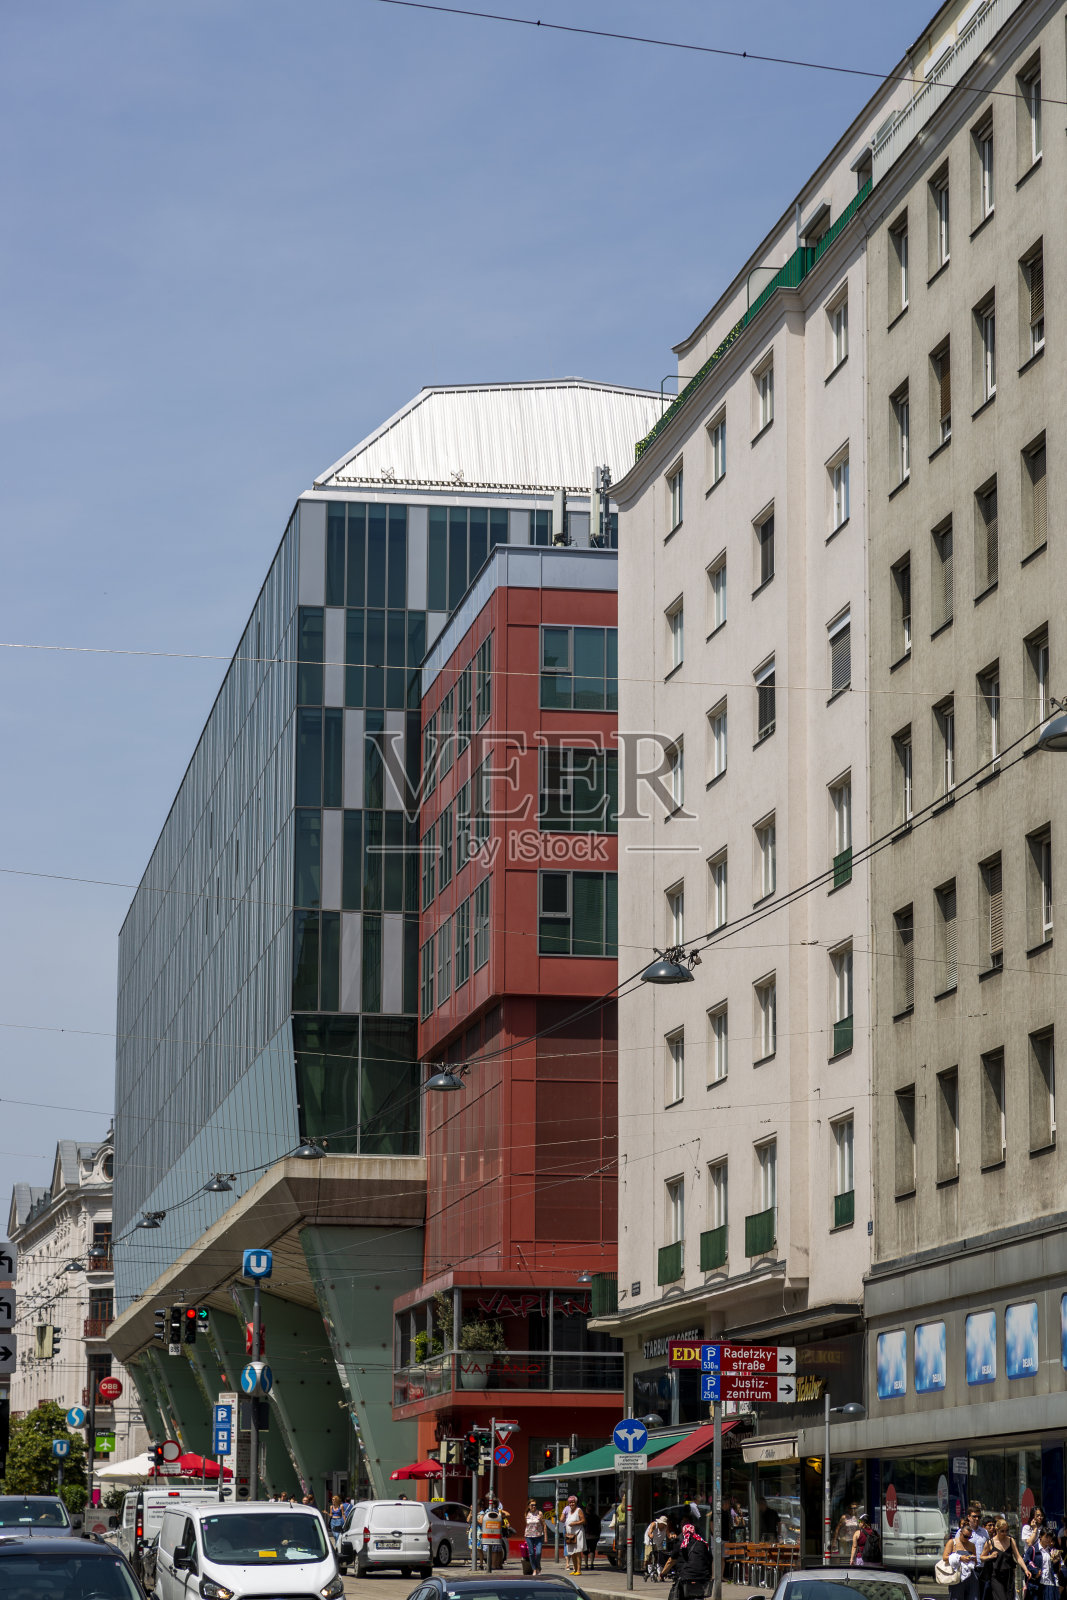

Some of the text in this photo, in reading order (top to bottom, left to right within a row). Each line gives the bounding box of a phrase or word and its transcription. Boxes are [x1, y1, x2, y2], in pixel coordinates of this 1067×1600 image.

[250, 1255, 267, 1273] U
[478, 1290, 592, 1318] VAPIAN
[723, 1348, 776, 1361] Radetzky-
[732, 1360, 766, 1371] straße
[731, 1378, 769, 1389] Justiz-
[726, 1390, 772, 1400] zentrum
